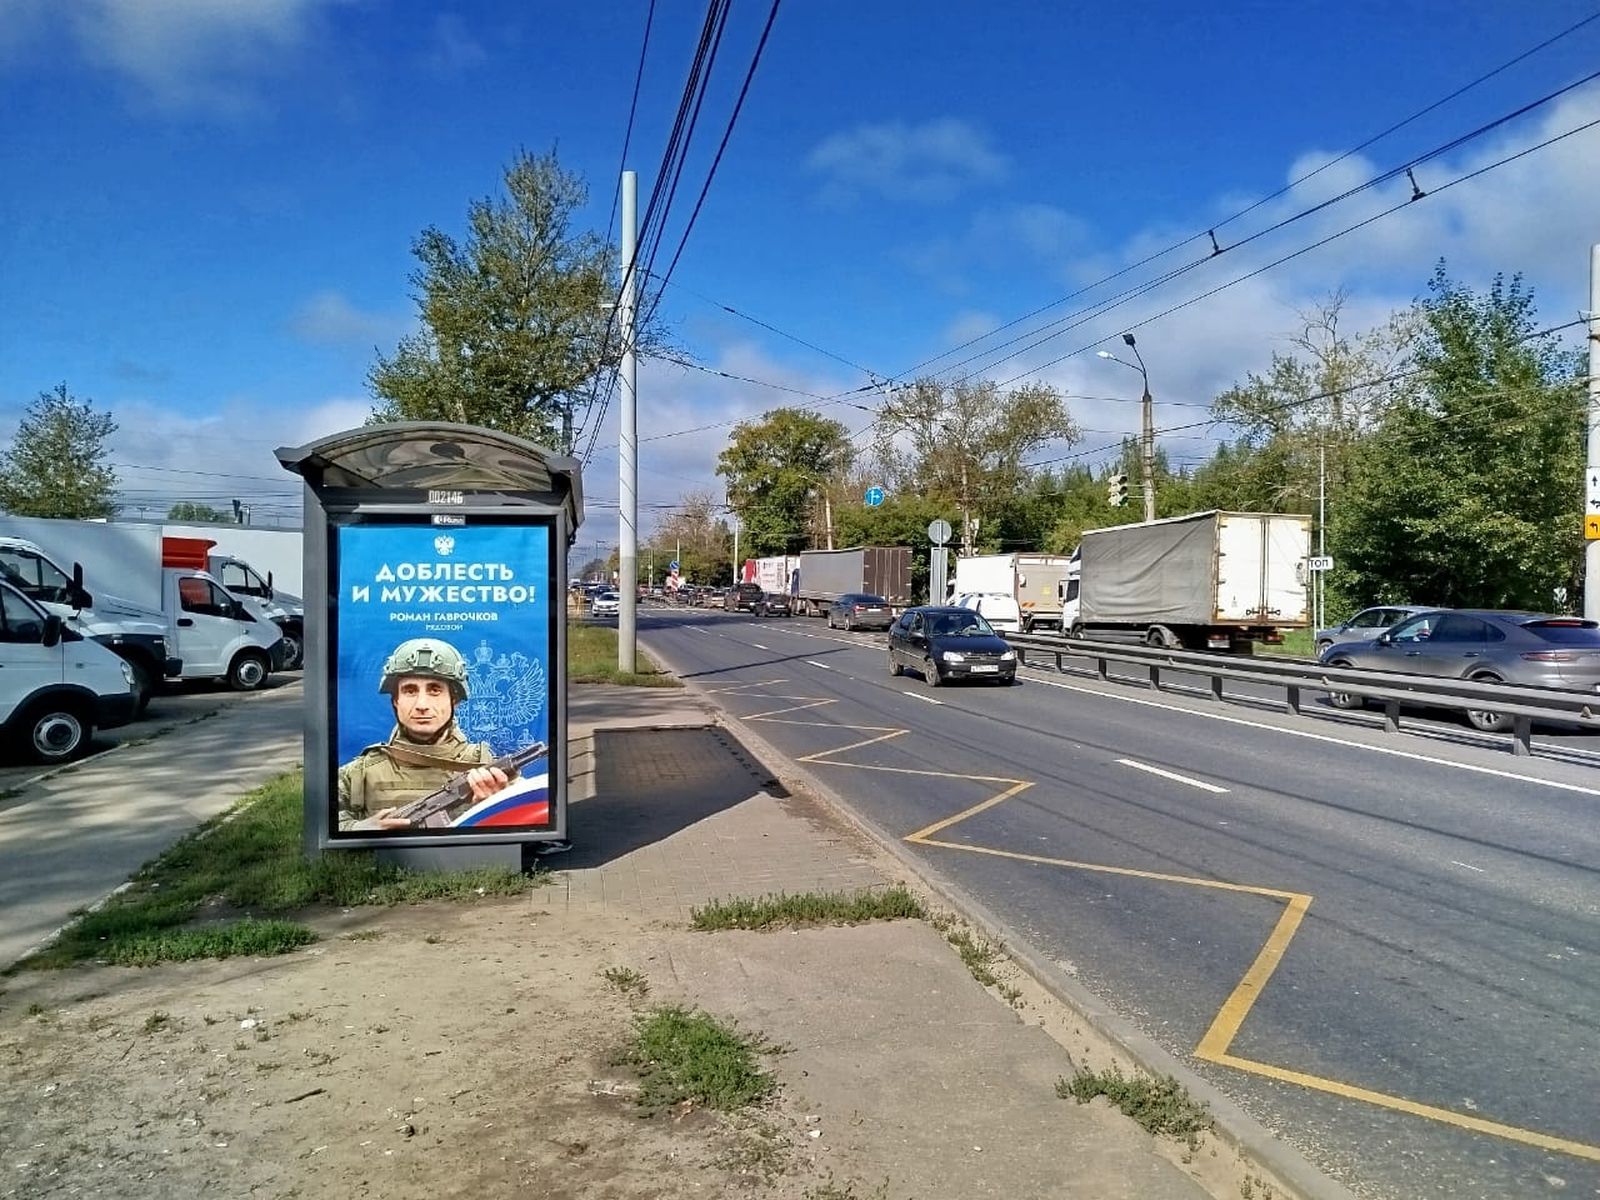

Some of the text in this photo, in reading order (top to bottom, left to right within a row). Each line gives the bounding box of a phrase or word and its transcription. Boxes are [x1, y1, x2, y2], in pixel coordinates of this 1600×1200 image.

[429, 490, 464, 504] 002146
[1310, 559, 1328, 568] ТОП
[375, 563, 514, 582] ДОБЛЕСТЬ
[352, 585, 536, 603] И МУЖЕСТВО!
[389, 612, 498, 621] РОМАН ГАВРОЧКОВ
